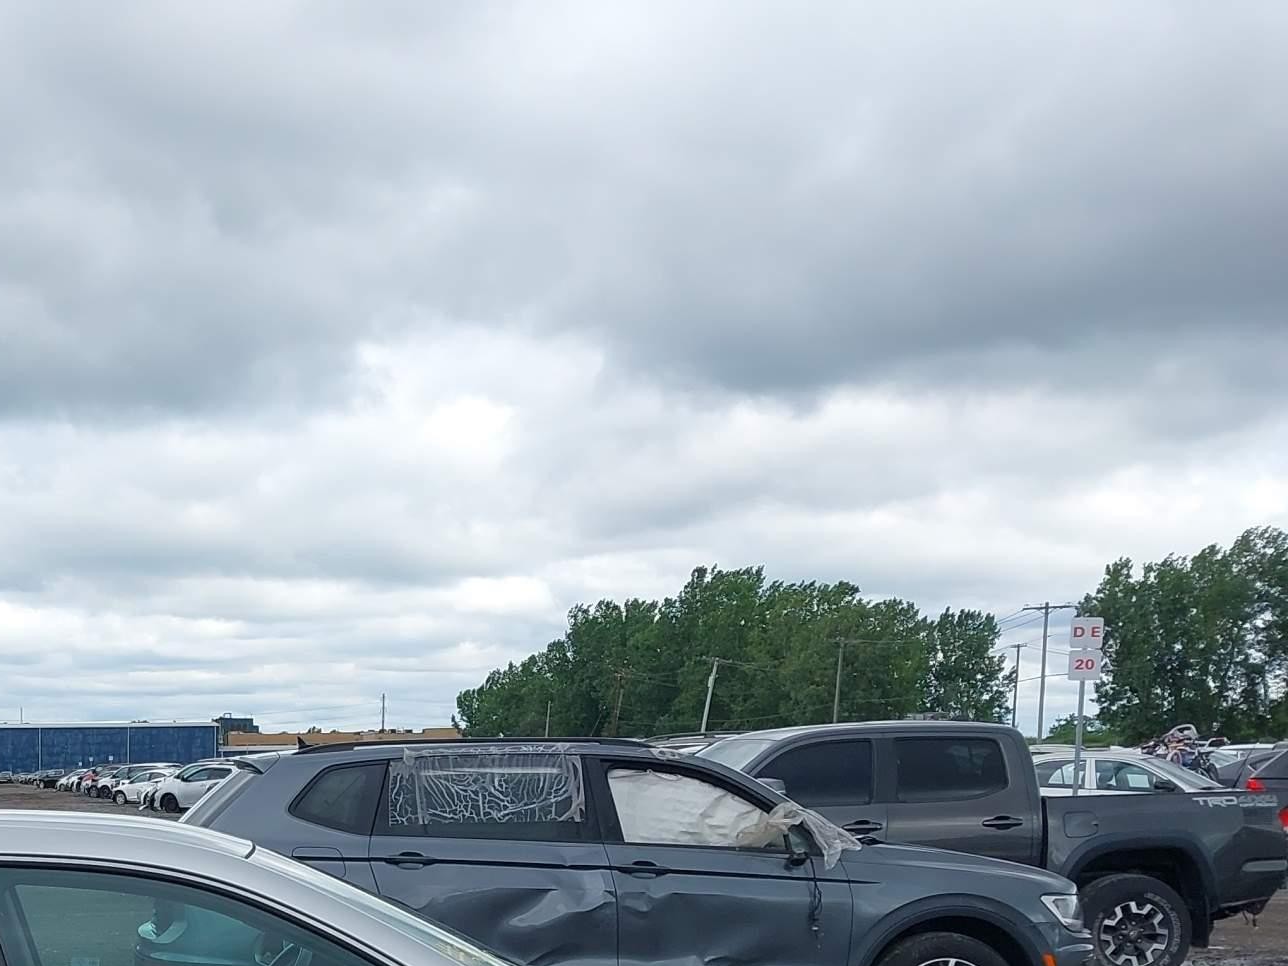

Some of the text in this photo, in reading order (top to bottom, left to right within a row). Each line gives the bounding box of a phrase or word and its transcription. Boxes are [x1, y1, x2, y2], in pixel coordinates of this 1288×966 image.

[1073, 626, 1101, 638] D E
[1074, 658, 1095, 670] 20
